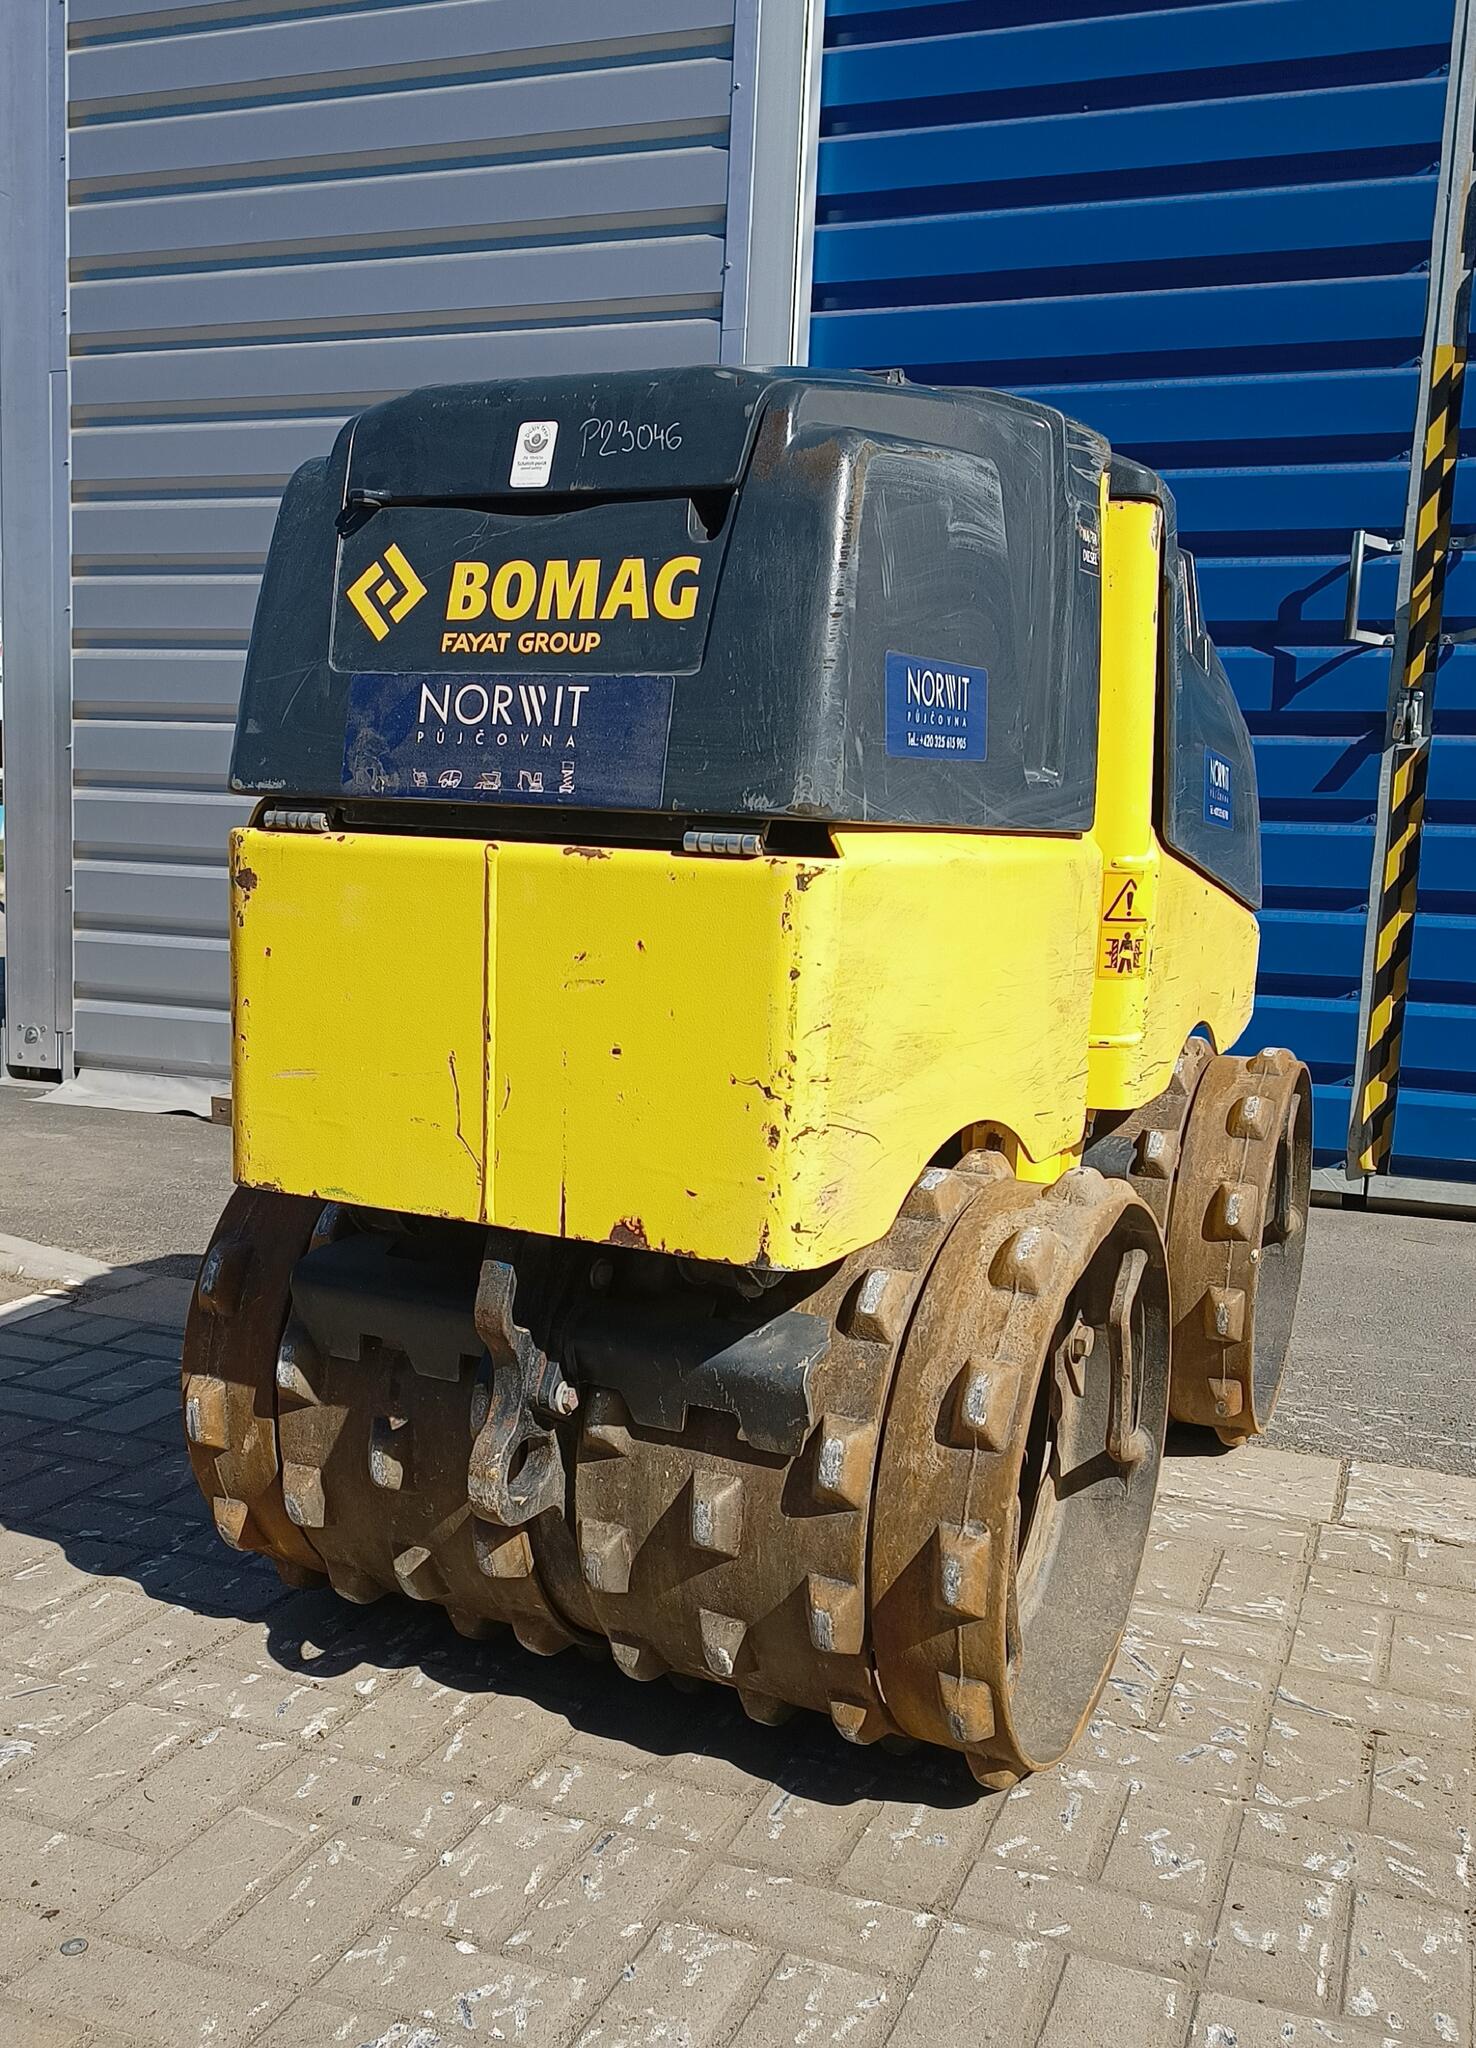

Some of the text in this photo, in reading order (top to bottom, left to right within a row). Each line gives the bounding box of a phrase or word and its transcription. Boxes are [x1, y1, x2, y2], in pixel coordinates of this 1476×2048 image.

[579, 417, 683, 458] P23046
[445, 556, 702, 621] BOMAG
[440, 631, 602, 654] FAYAT GROUP
[418, 683, 590, 728] NORWIT
[907, 666, 970, 712] NORWIT
[416, 728, 576, 748] PŮJČOVNA
[907, 709, 967, 727] PŮJČOVNA
